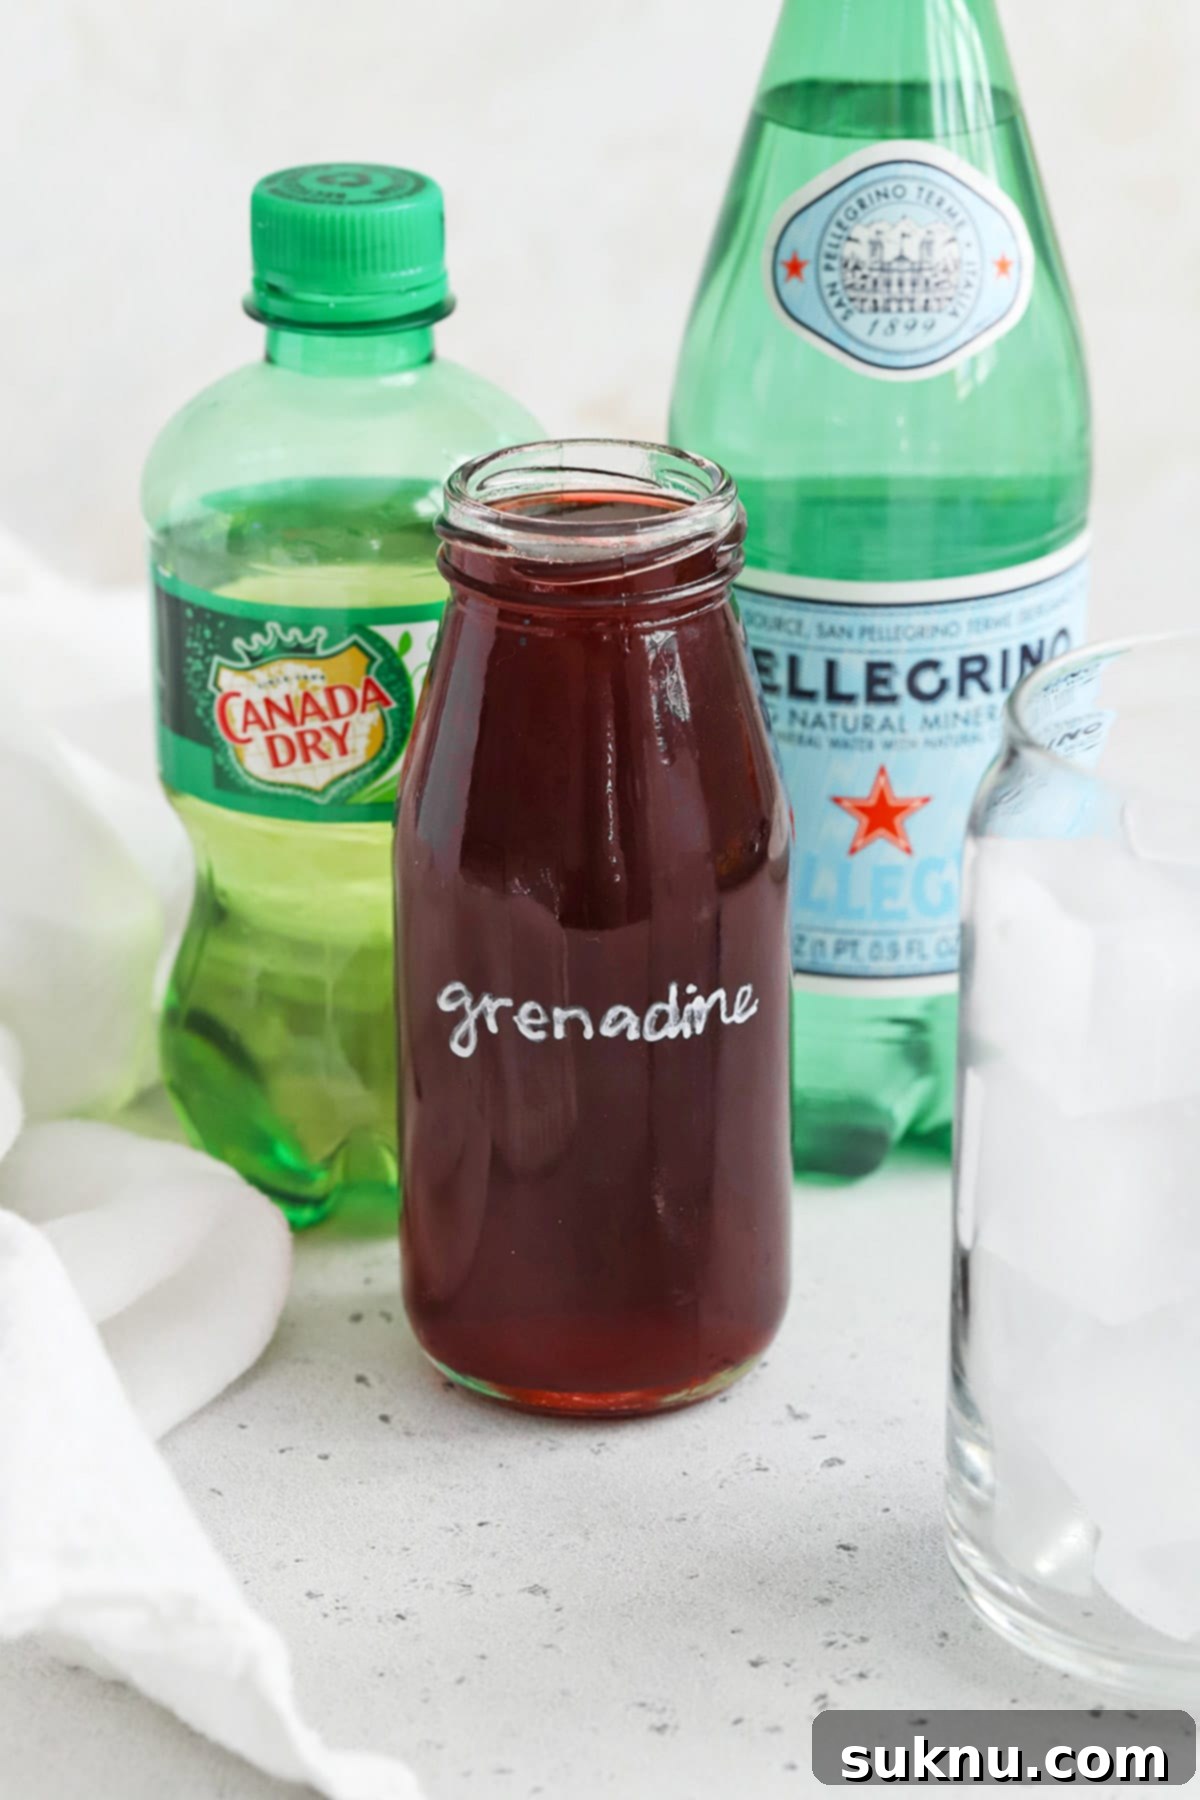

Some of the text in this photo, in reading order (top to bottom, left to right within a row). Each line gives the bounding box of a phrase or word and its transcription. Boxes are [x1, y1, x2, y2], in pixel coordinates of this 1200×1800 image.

[822, 183, 908, 272] PELLEGRINO
[915, 185, 968, 230] TERME
[824, 281, 855, 323] SAN
[867, 317, 937, 338] 1899
[858, 621, 961, 644] PELLEGRINO
[216, 676, 395, 744] CANADA
[787, 708, 907, 735] NATURAL
[265, 721, 351, 769] DRY
[437, 981, 759, 1058] grenadine
